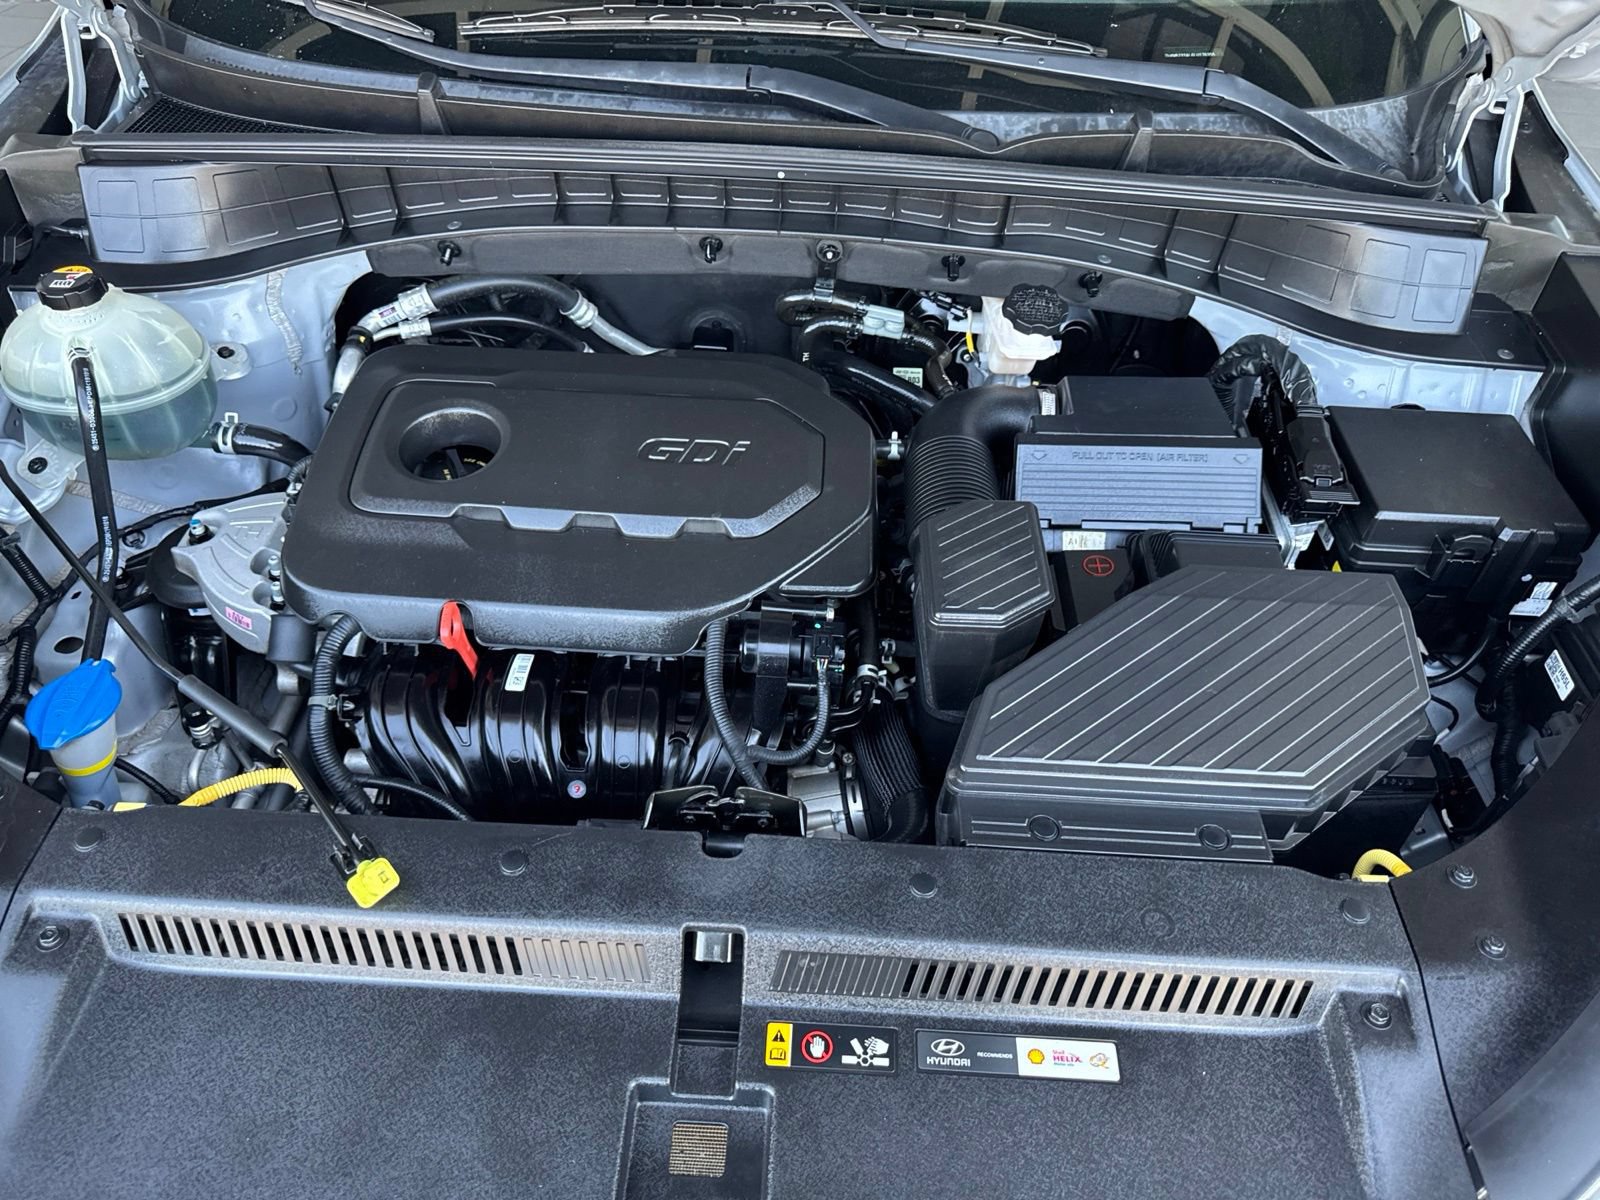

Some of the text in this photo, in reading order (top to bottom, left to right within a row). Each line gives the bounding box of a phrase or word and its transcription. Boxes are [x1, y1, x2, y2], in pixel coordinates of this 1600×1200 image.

[637, 437, 751, 465] GDi
[1072, 451, 1095, 460] PULL
[1096, 452, 1114, 460] OUT
[1116, 452, 1127, 461] TO
[1129, 452, 1153, 461] OPEN
[977, 1051, 1013, 1059] RECOMMENDS
[1053, 1055, 1081, 1063] HELIX
[926, 1056, 971, 1066] HYUNDAI
